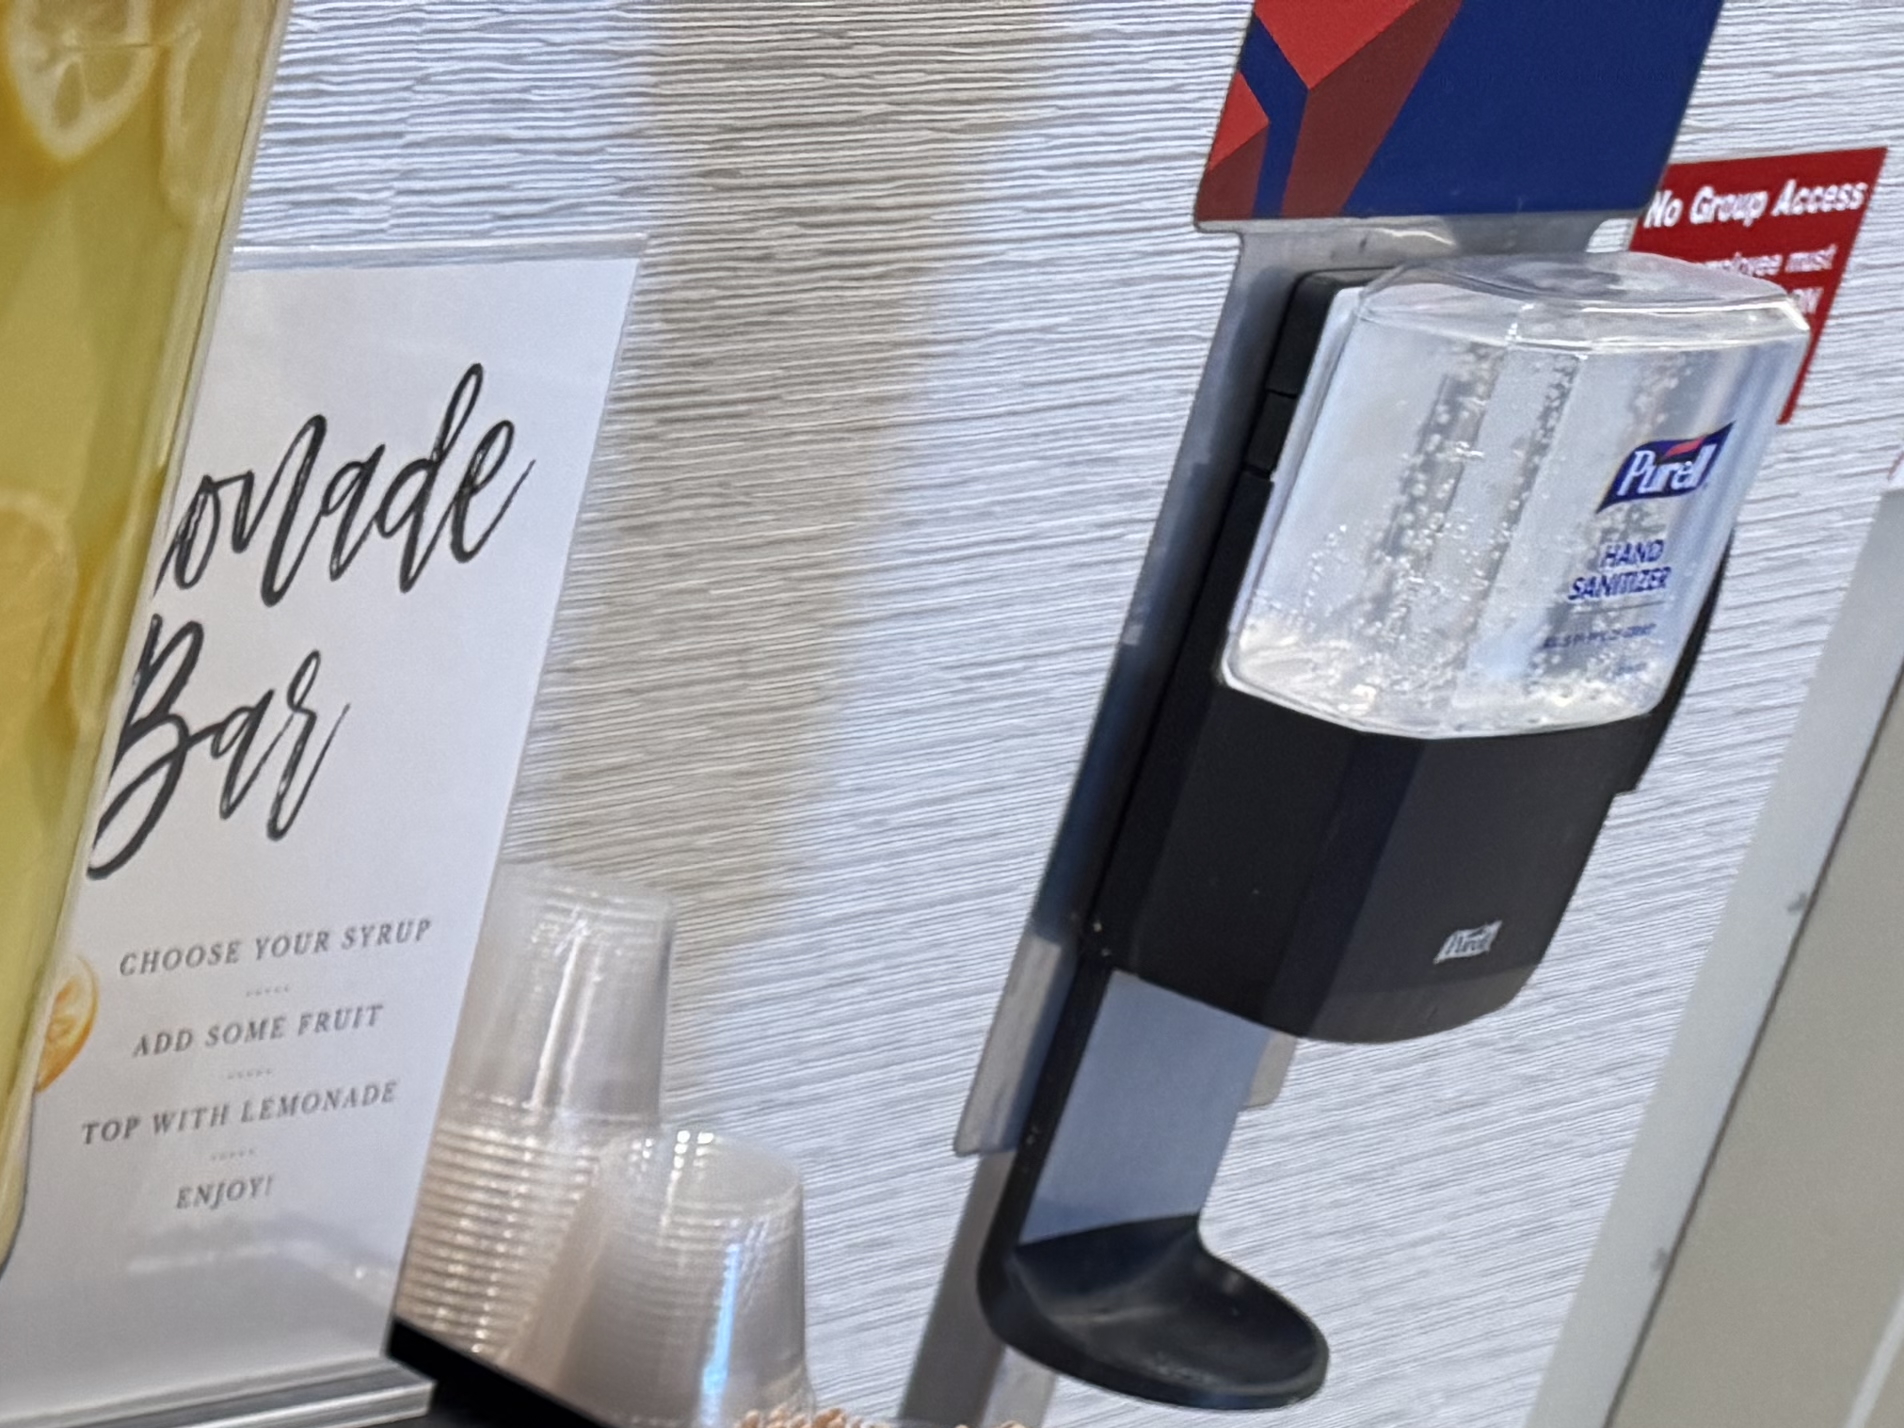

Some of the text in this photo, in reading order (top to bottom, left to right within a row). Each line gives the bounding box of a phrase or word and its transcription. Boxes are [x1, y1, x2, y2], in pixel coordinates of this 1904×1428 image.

[1643, 178, 1869, 229] No Group Access
[1785, 243, 1838, 273] must
[152, 362, 536, 607] onade
[1616, 442, 1719, 497] Purell
[1599, 539, 1665, 568] HAND
[1567, 566, 1672, 601] SANITIZER
[87, 613, 351, 880] Bar
[118, 917, 433, 977] CHOOSE YOUR SYRUP
[132, 1004, 385, 1058] ADD SOME FRUIT
[82, 1081, 399, 1146] TOP WITH LEMONADE
[175, 1175, 275, 1212] ENJOY!
